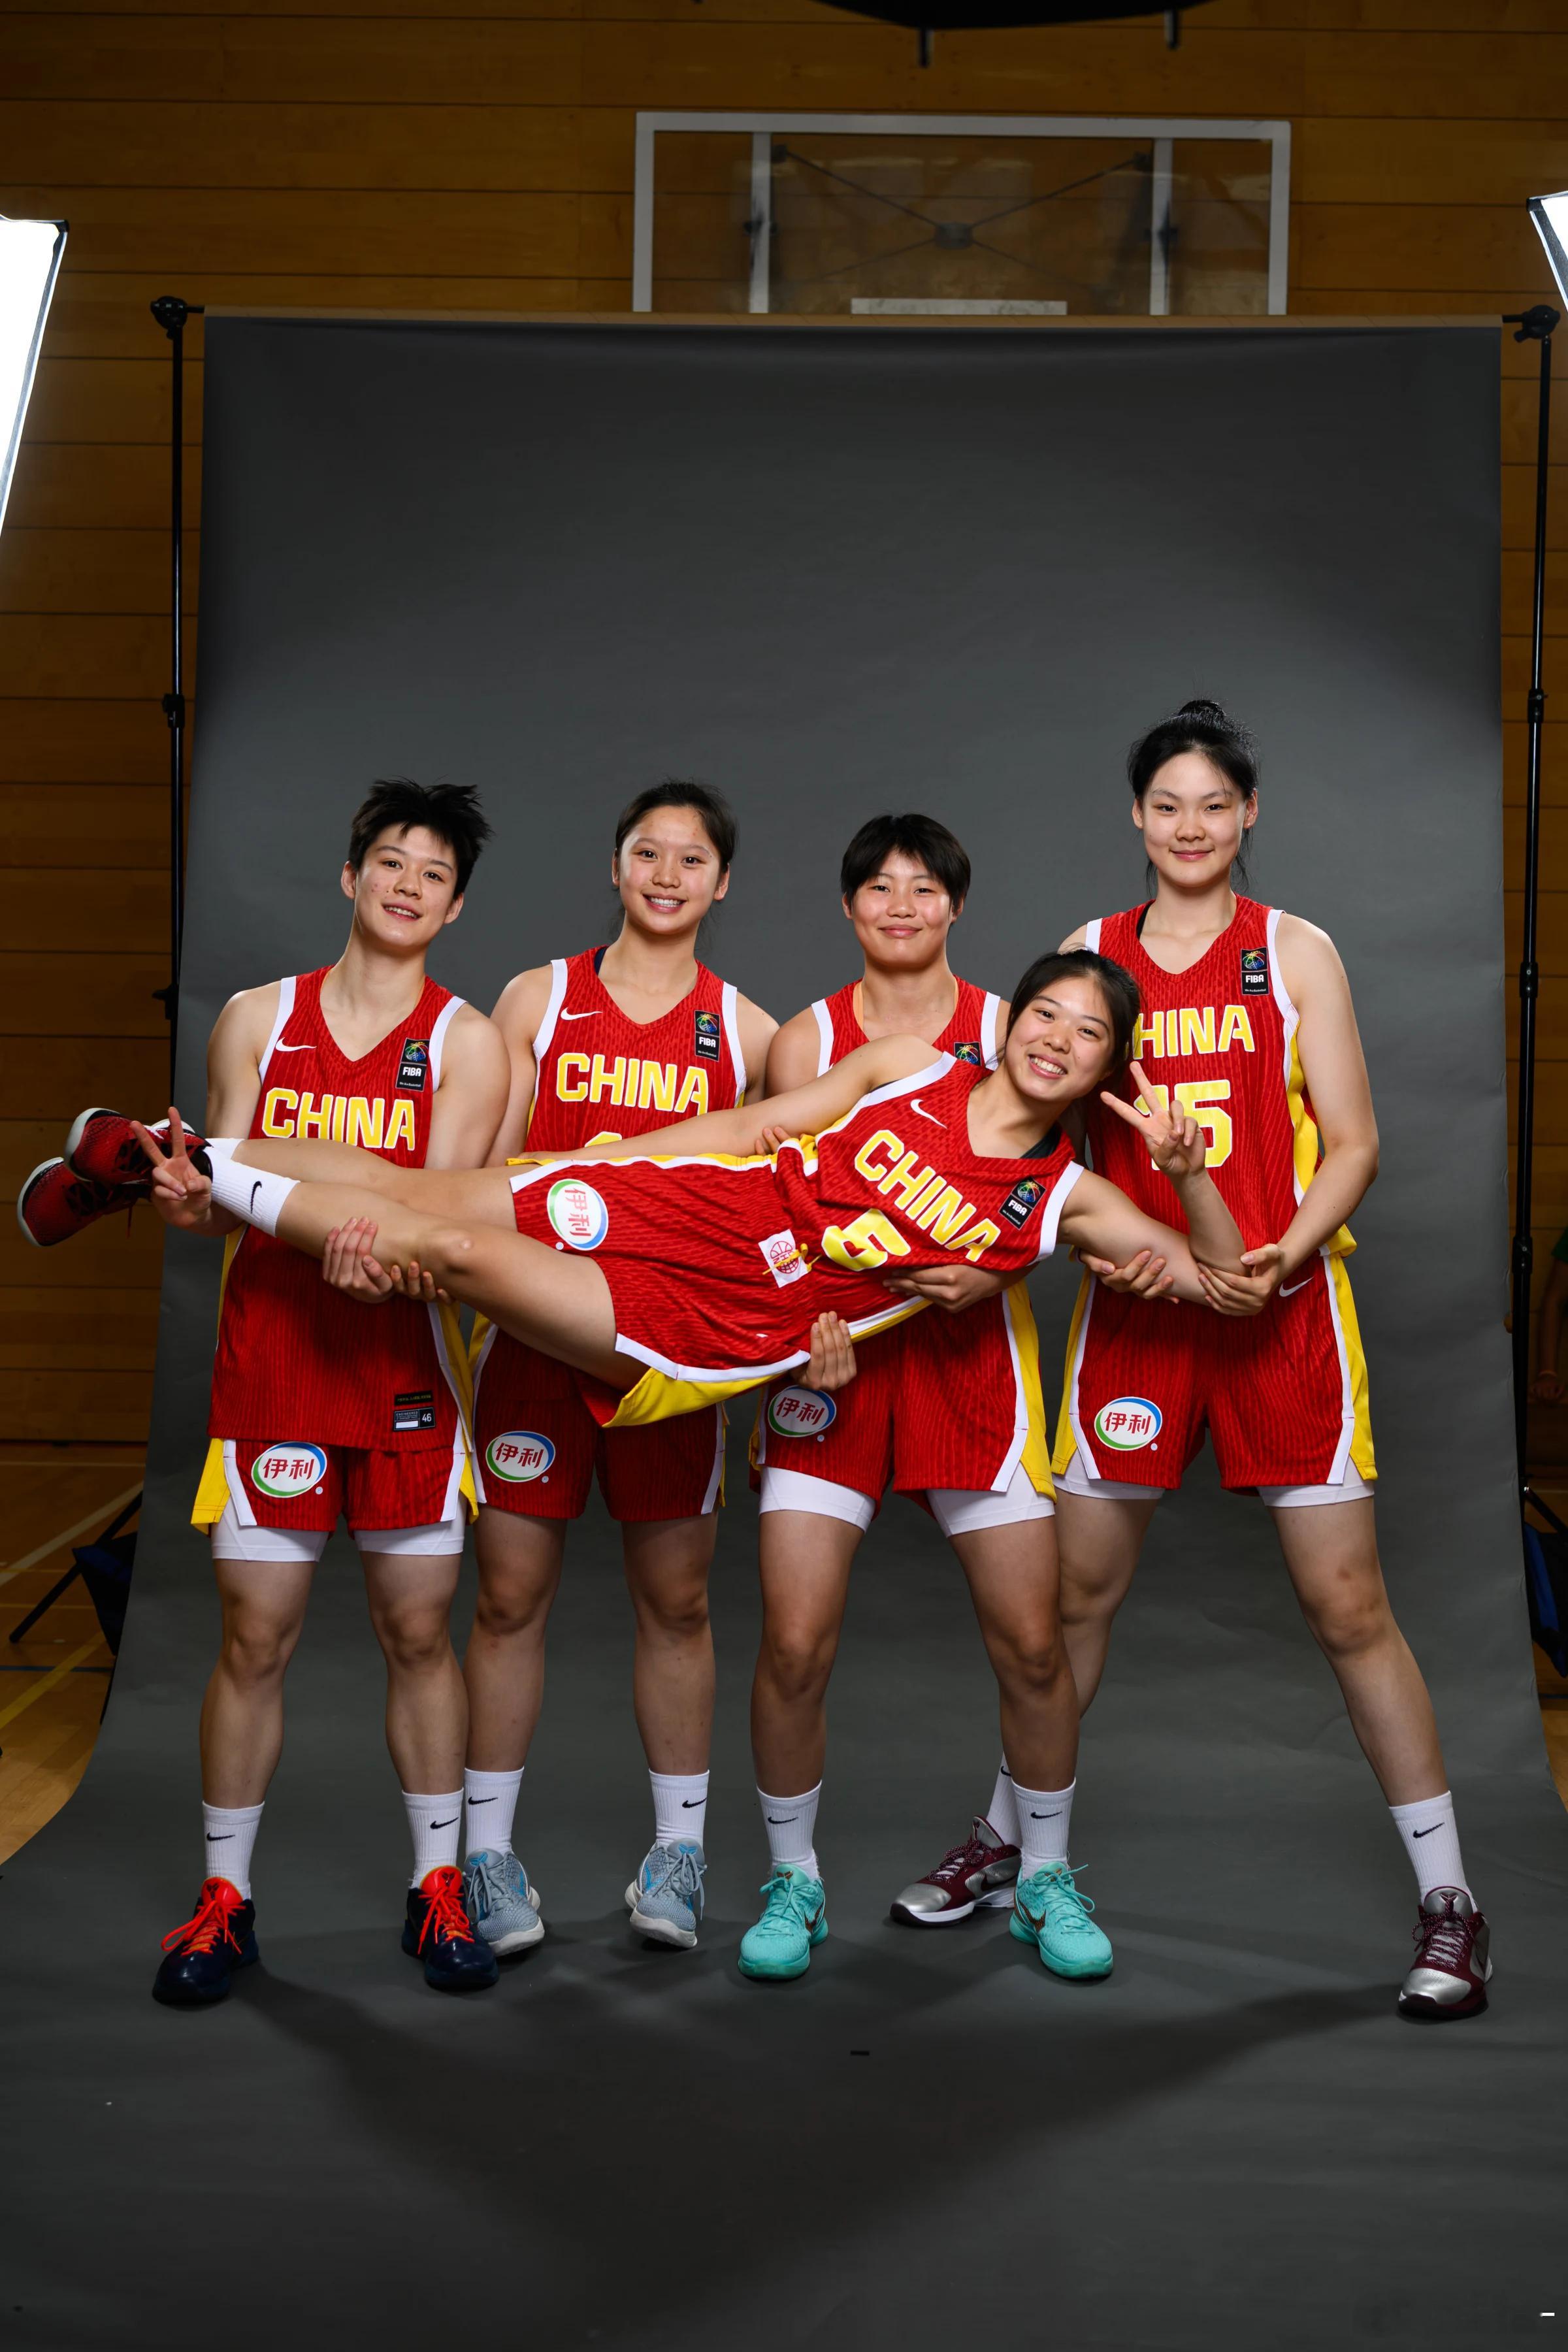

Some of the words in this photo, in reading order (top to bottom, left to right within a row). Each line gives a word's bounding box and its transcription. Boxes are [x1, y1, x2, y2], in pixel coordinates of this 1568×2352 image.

[1245, 974, 1264, 983] FIBA
[699, 1036, 716, 1048] FIBA
[1125, 1004, 1255, 1060] HINA
[402, 1066, 422, 1077] FIBA
[556, 1053, 709, 1115] CHINA
[261, 1087, 416, 1151] CHINA
[854, 1129, 1001, 1262] CHINA
[1008, 1199, 1027, 1217] FIBA
[564, 1188, 592, 1237] 伊利
[422, 1413, 432, 1422] 46
[776, 1396, 825, 1426] 伊利
[1104, 1412, 1152, 1435] 伊利
[495, 1442, 544, 1469] 伊利
[263, 1458, 315, 1480] 伊利
